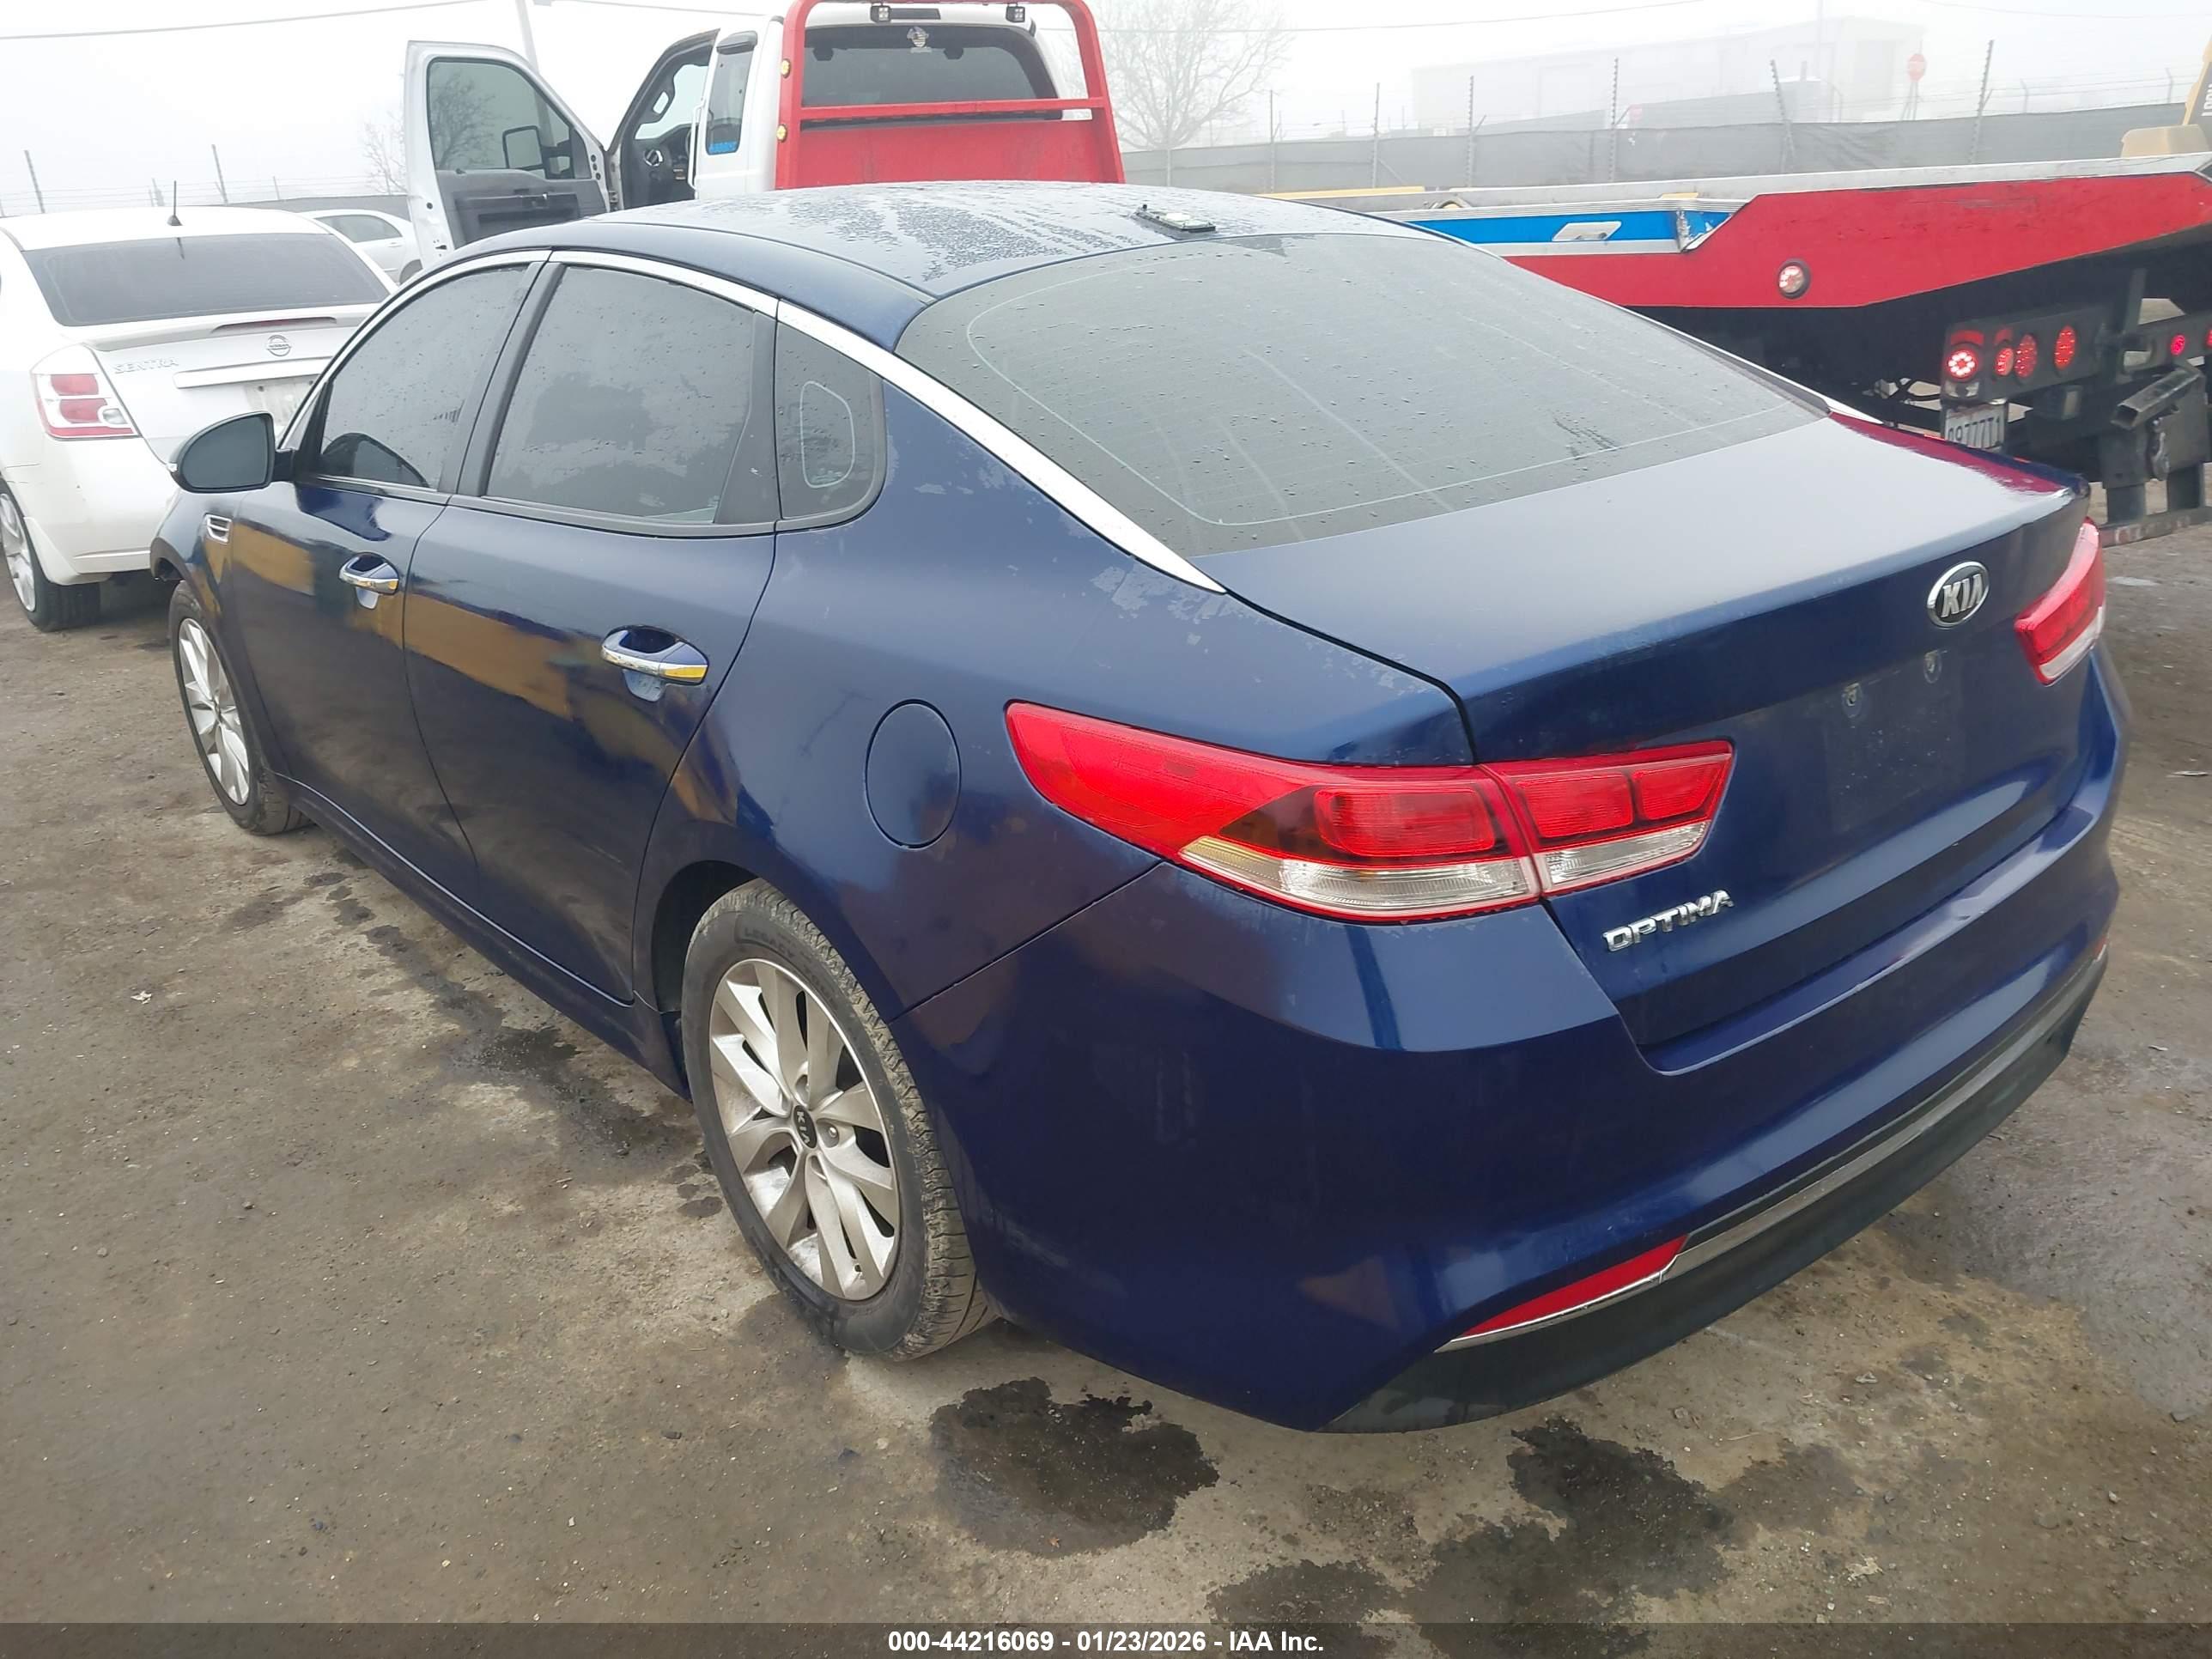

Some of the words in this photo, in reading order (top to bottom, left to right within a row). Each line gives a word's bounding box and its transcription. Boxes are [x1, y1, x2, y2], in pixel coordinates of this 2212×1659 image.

[1940, 573, 1984, 618] KIA
[1602, 890, 1735, 952] OPTIMA
[796, 1110, 811, 1144] KIA
